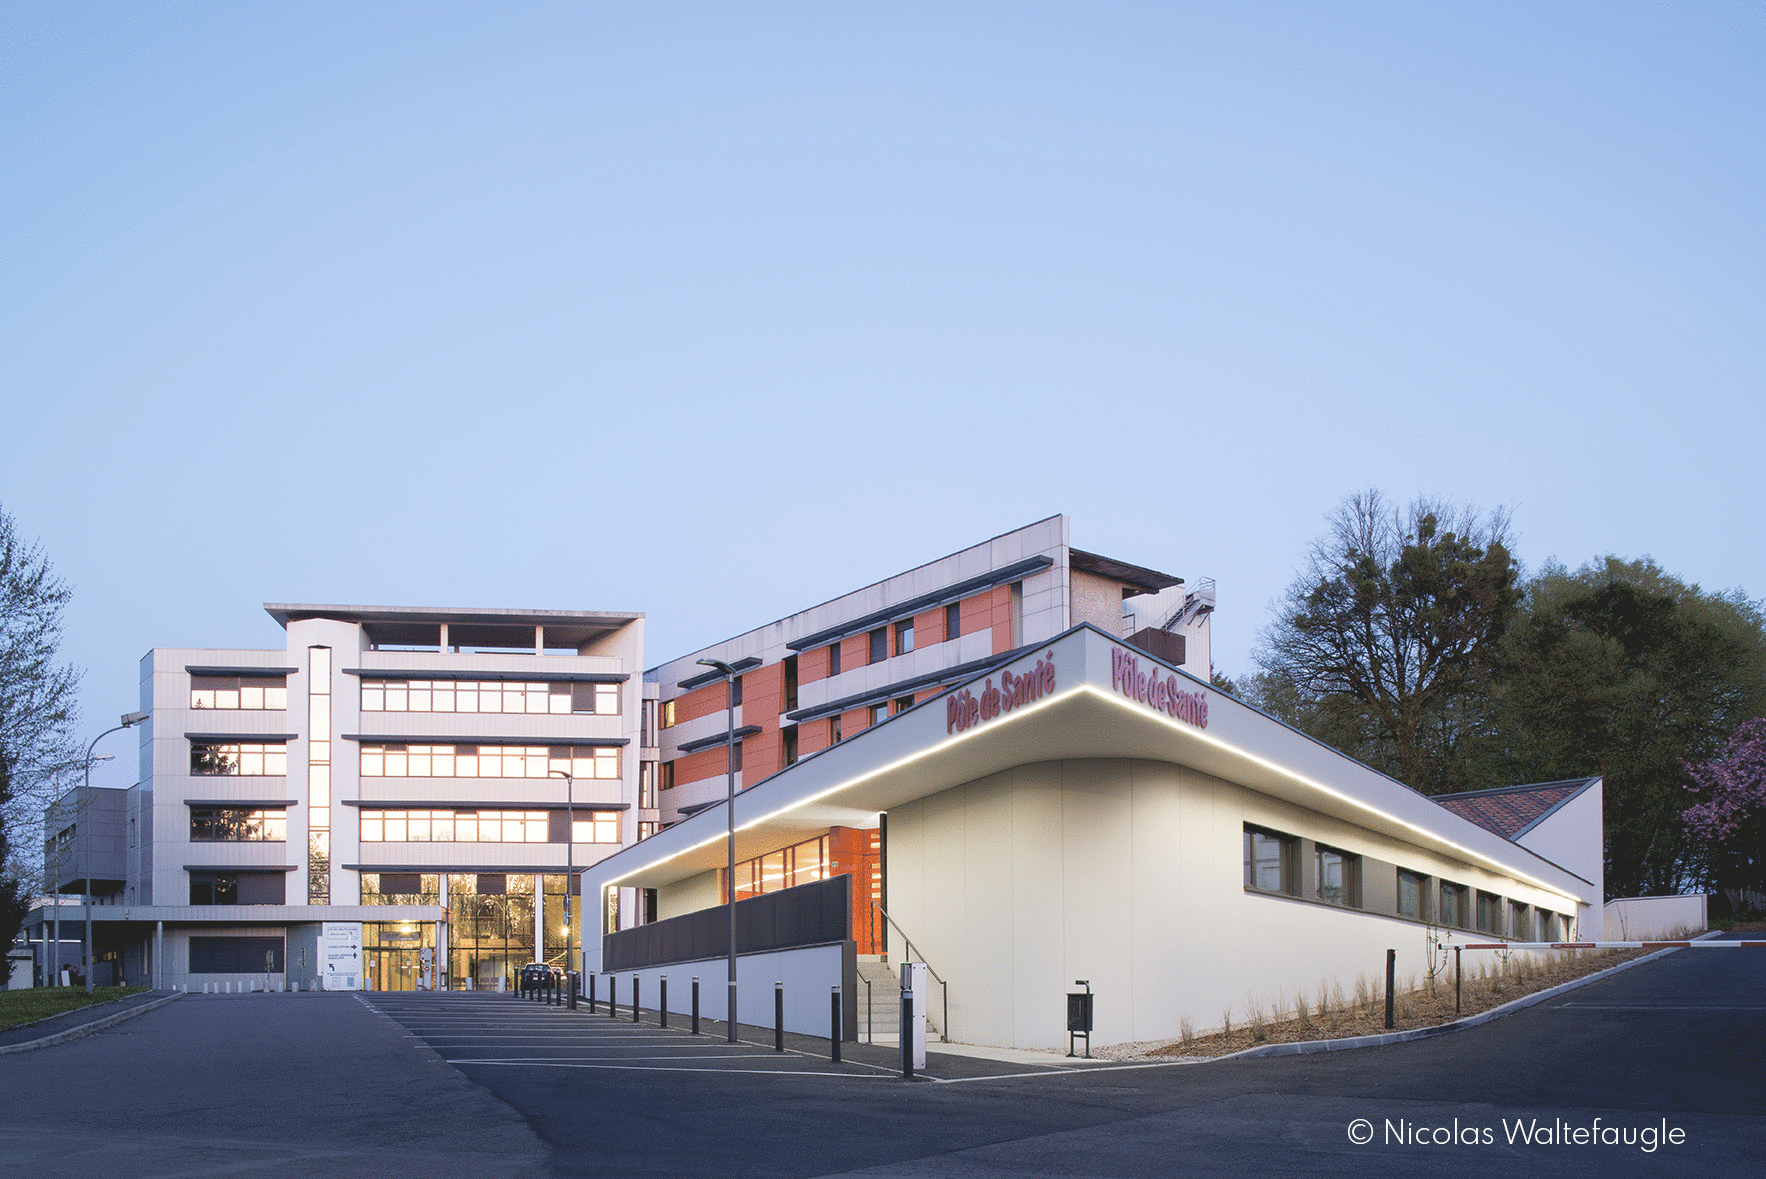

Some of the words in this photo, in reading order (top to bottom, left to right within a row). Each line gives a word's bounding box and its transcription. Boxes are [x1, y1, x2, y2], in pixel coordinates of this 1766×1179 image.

[947, 688, 979, 735] Pôle
[980, 677, 1001, 721] de
[1001, 649, 1056, 712] Santé
[1111, 646, 1147, 703] Pôle
[1147, 666, 1166, 712] de
[1166, 674, 1209, 730] Santé
